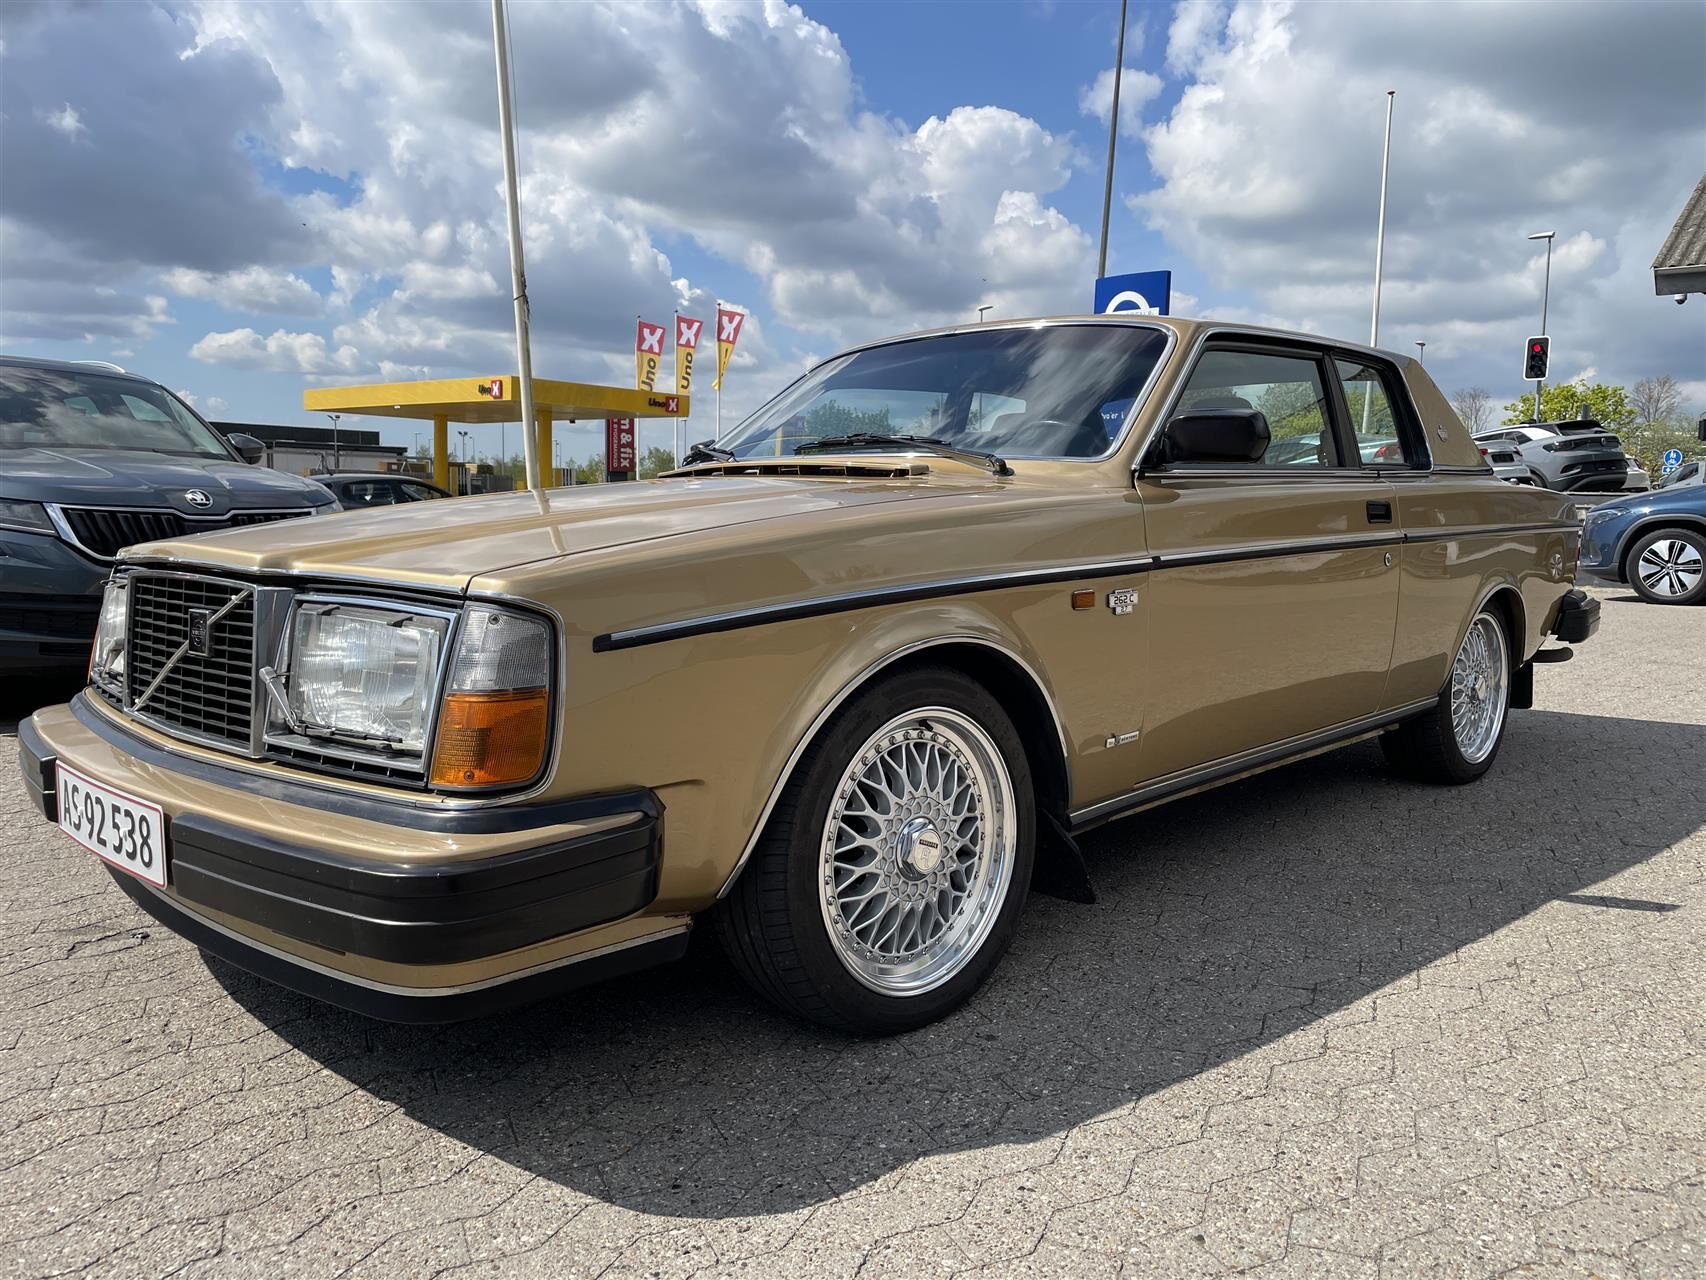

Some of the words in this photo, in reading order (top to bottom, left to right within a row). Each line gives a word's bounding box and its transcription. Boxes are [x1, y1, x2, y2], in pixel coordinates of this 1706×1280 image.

[641, 328, 664, 353] X
[678, 322, 701, 347] X
[719, 315, 742, 342] X
[681, 352, 693, 389] Uno
[620, 448, 633, 467] fix
[64, 778, 82, 831] AS
[84, 791, 107, 848] 92
[111, 802, 153, 869] 538
